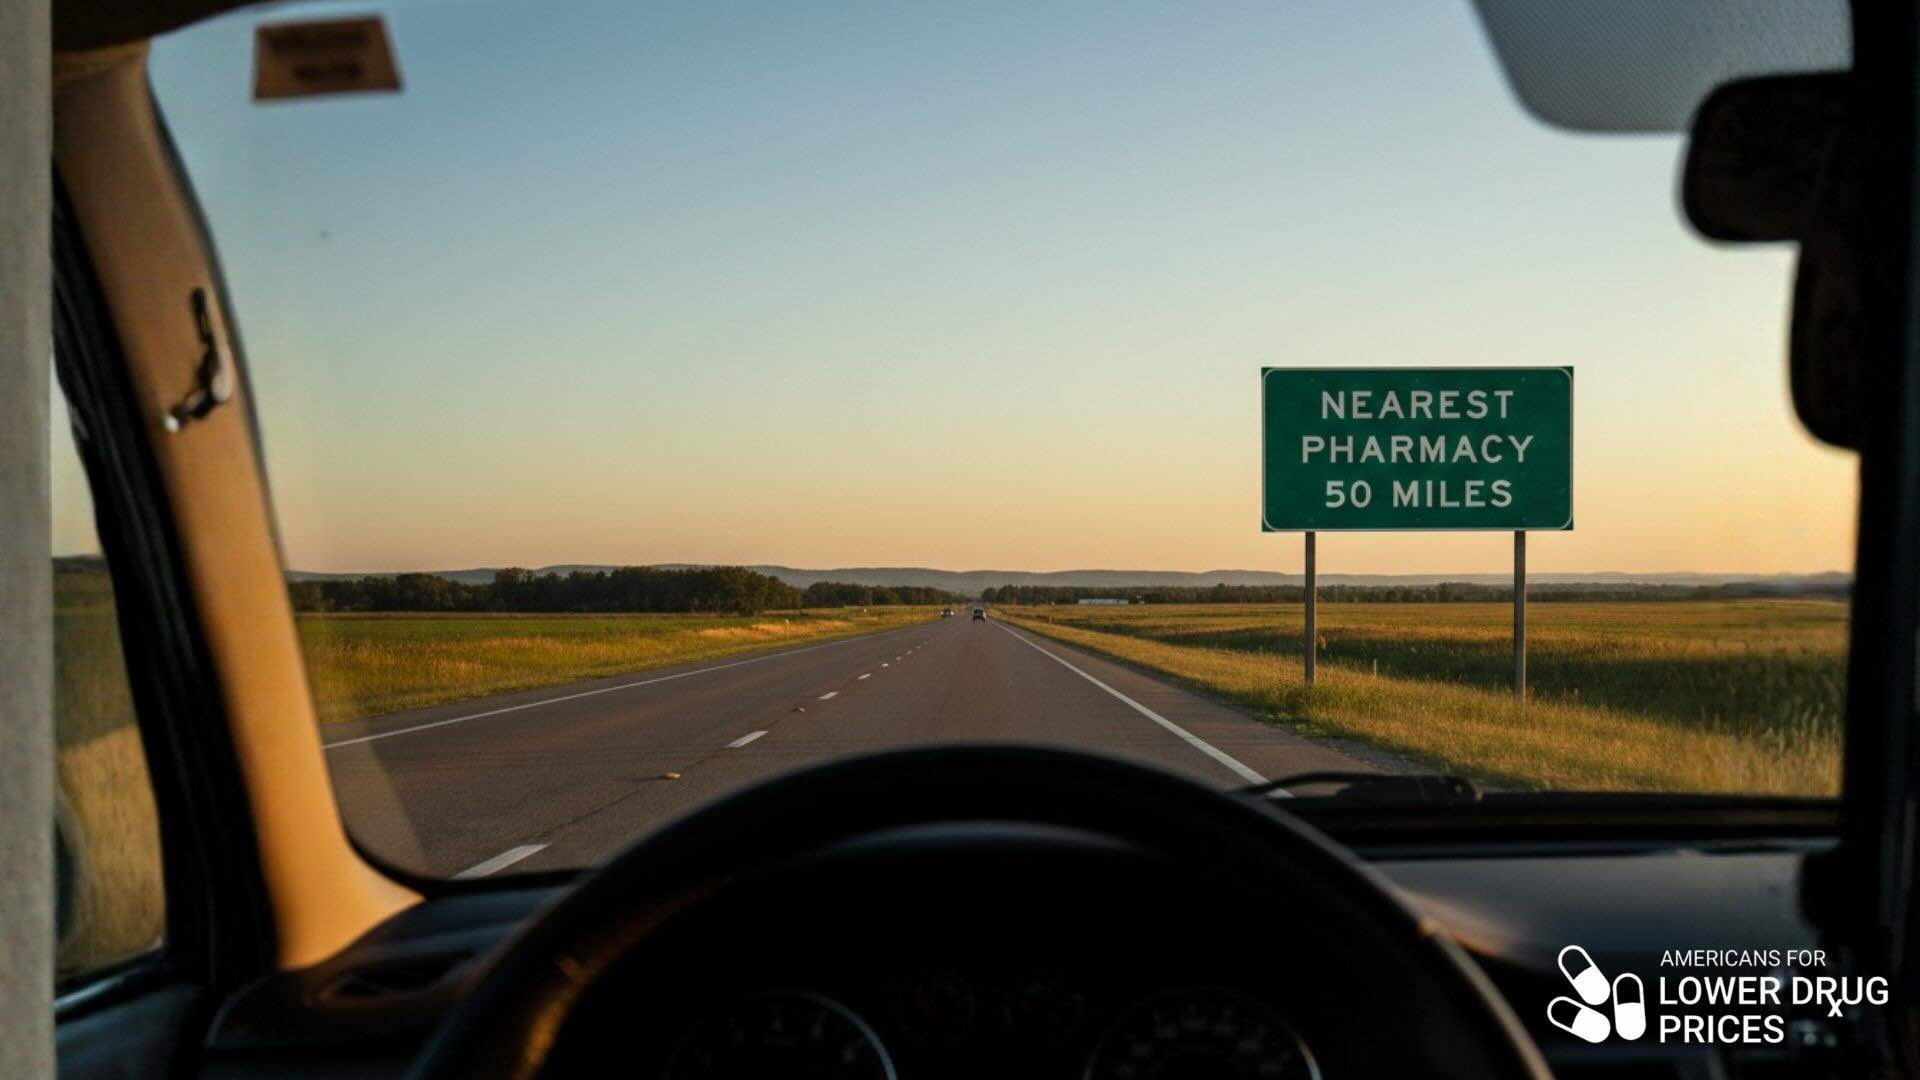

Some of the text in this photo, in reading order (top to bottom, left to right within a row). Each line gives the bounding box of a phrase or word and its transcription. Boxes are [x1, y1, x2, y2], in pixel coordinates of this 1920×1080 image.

[1322, 390, 1514, 418] NEAREST
[1302, 435, 1534, 463] PHARMACY
[1325, 480, 1513, 508] 50 MILES
